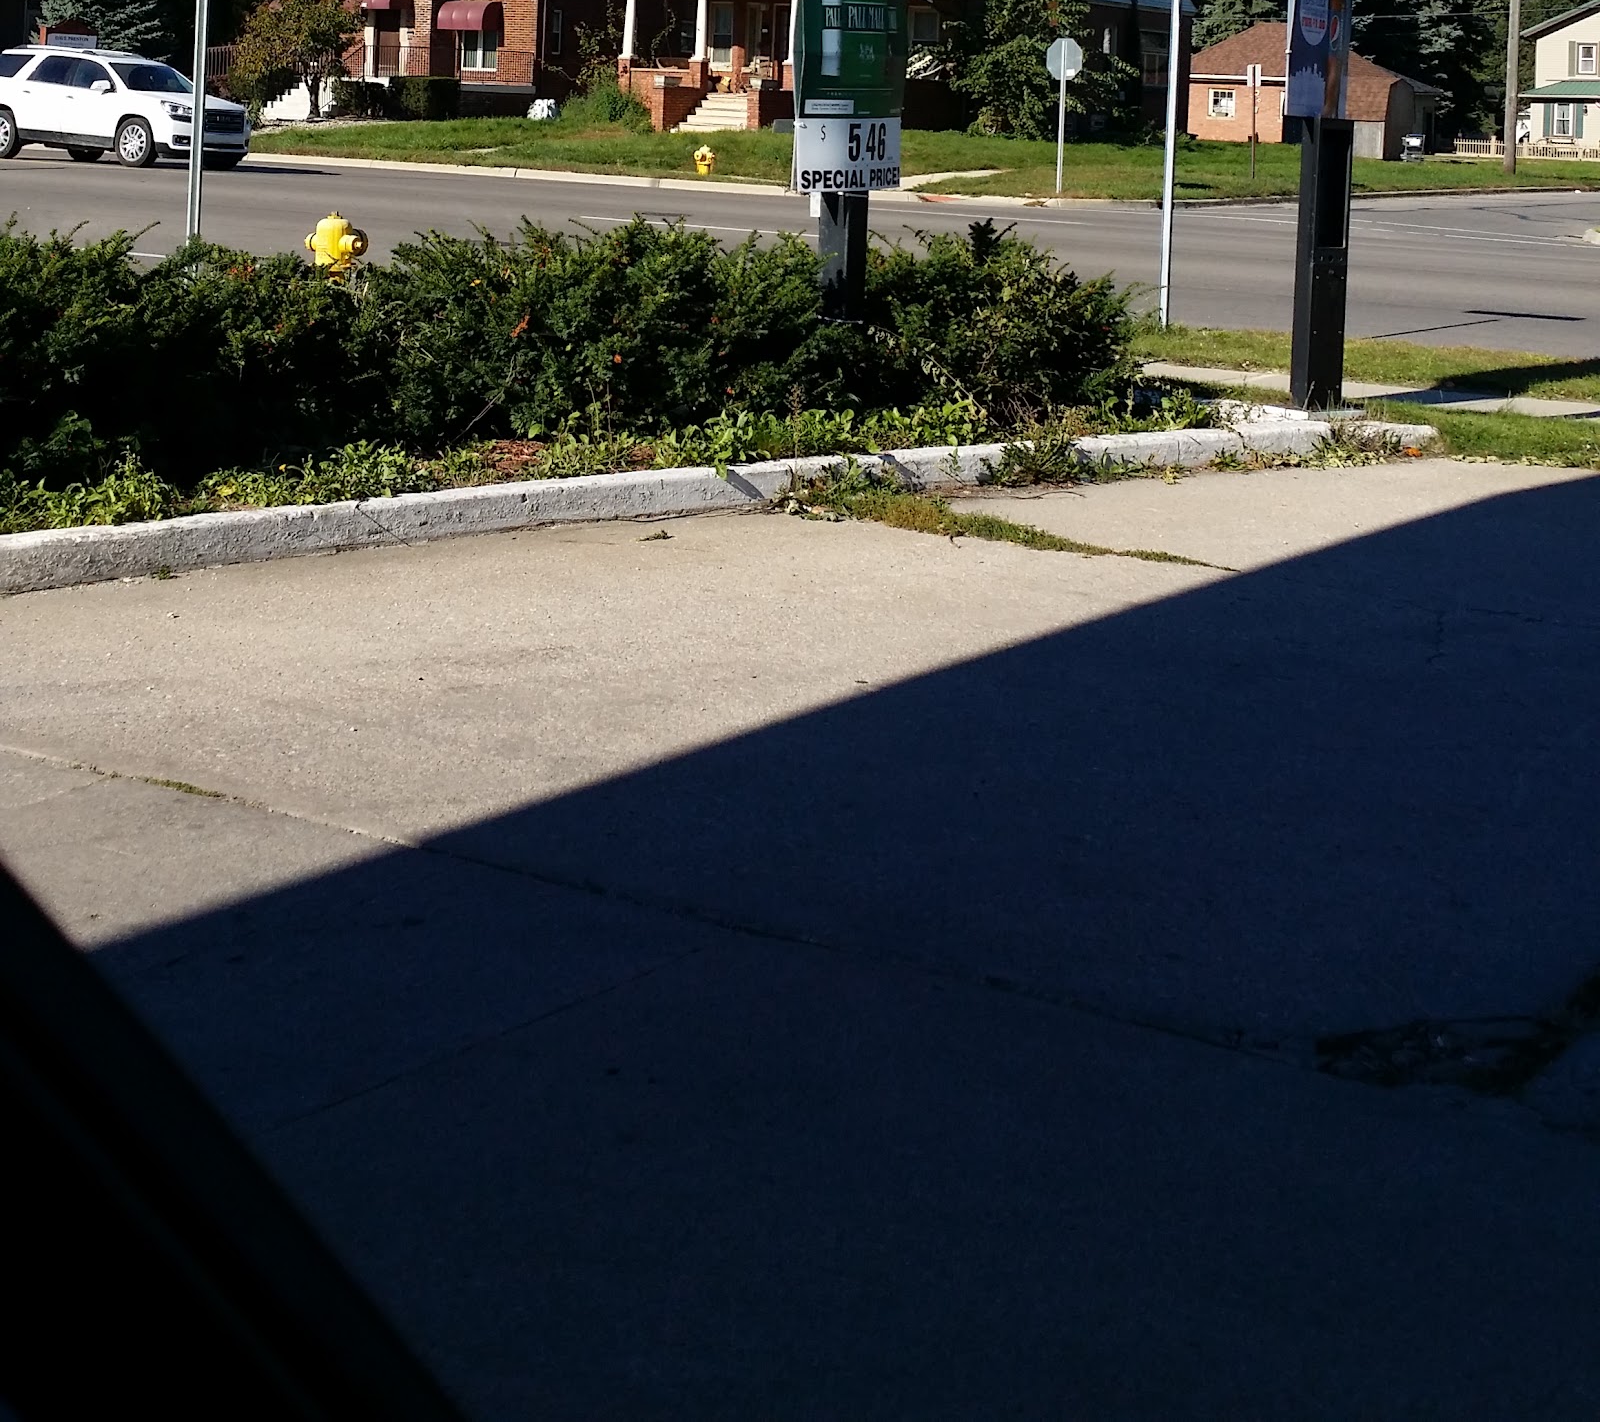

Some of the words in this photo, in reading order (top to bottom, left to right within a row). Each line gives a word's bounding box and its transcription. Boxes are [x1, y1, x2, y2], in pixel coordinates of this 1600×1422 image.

[848, 5, 866, 29] PALL
[869, 6, 884, 30] MALL
[820, 124, 826, 142] $
[848, 122, 887, 162] 5.46
[801, 169, 866, 190] SPECIAL
